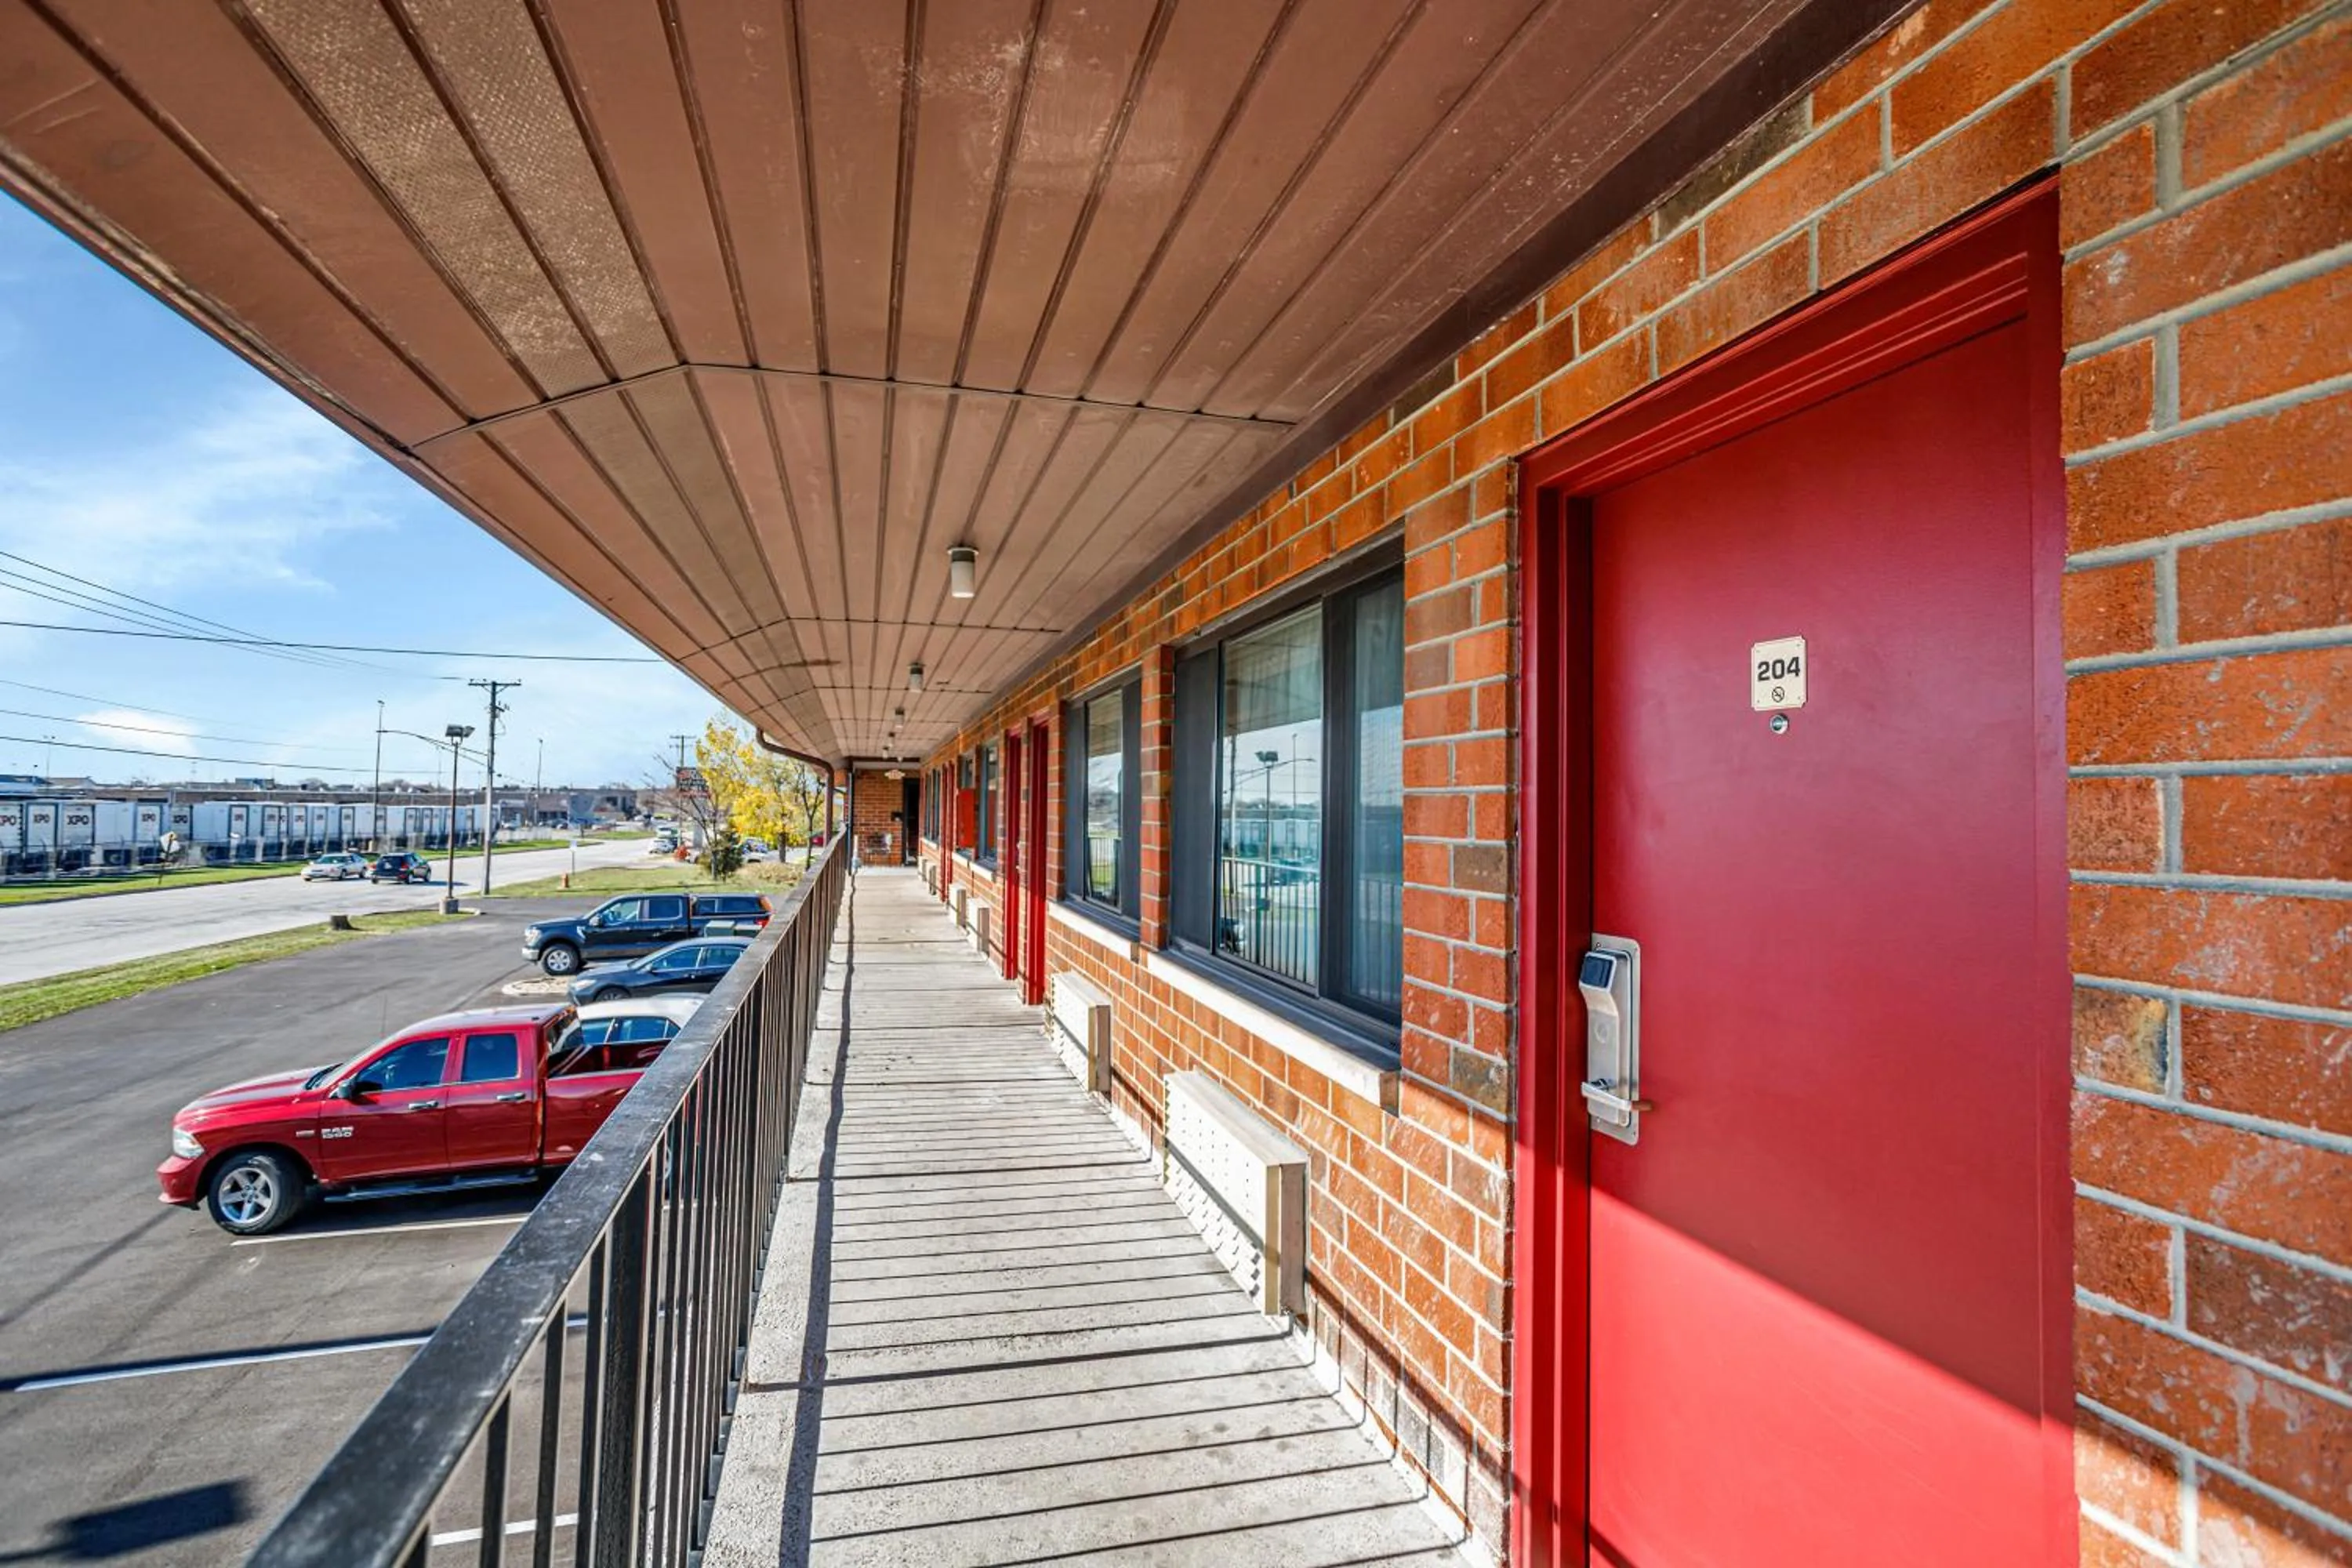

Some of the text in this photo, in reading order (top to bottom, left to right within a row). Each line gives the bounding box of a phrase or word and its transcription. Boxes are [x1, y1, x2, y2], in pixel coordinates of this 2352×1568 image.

[1757, 656, 1801, 682] 204
[67, 815, 89, 826] XPO
[173, 815, 188, 824] XPO
